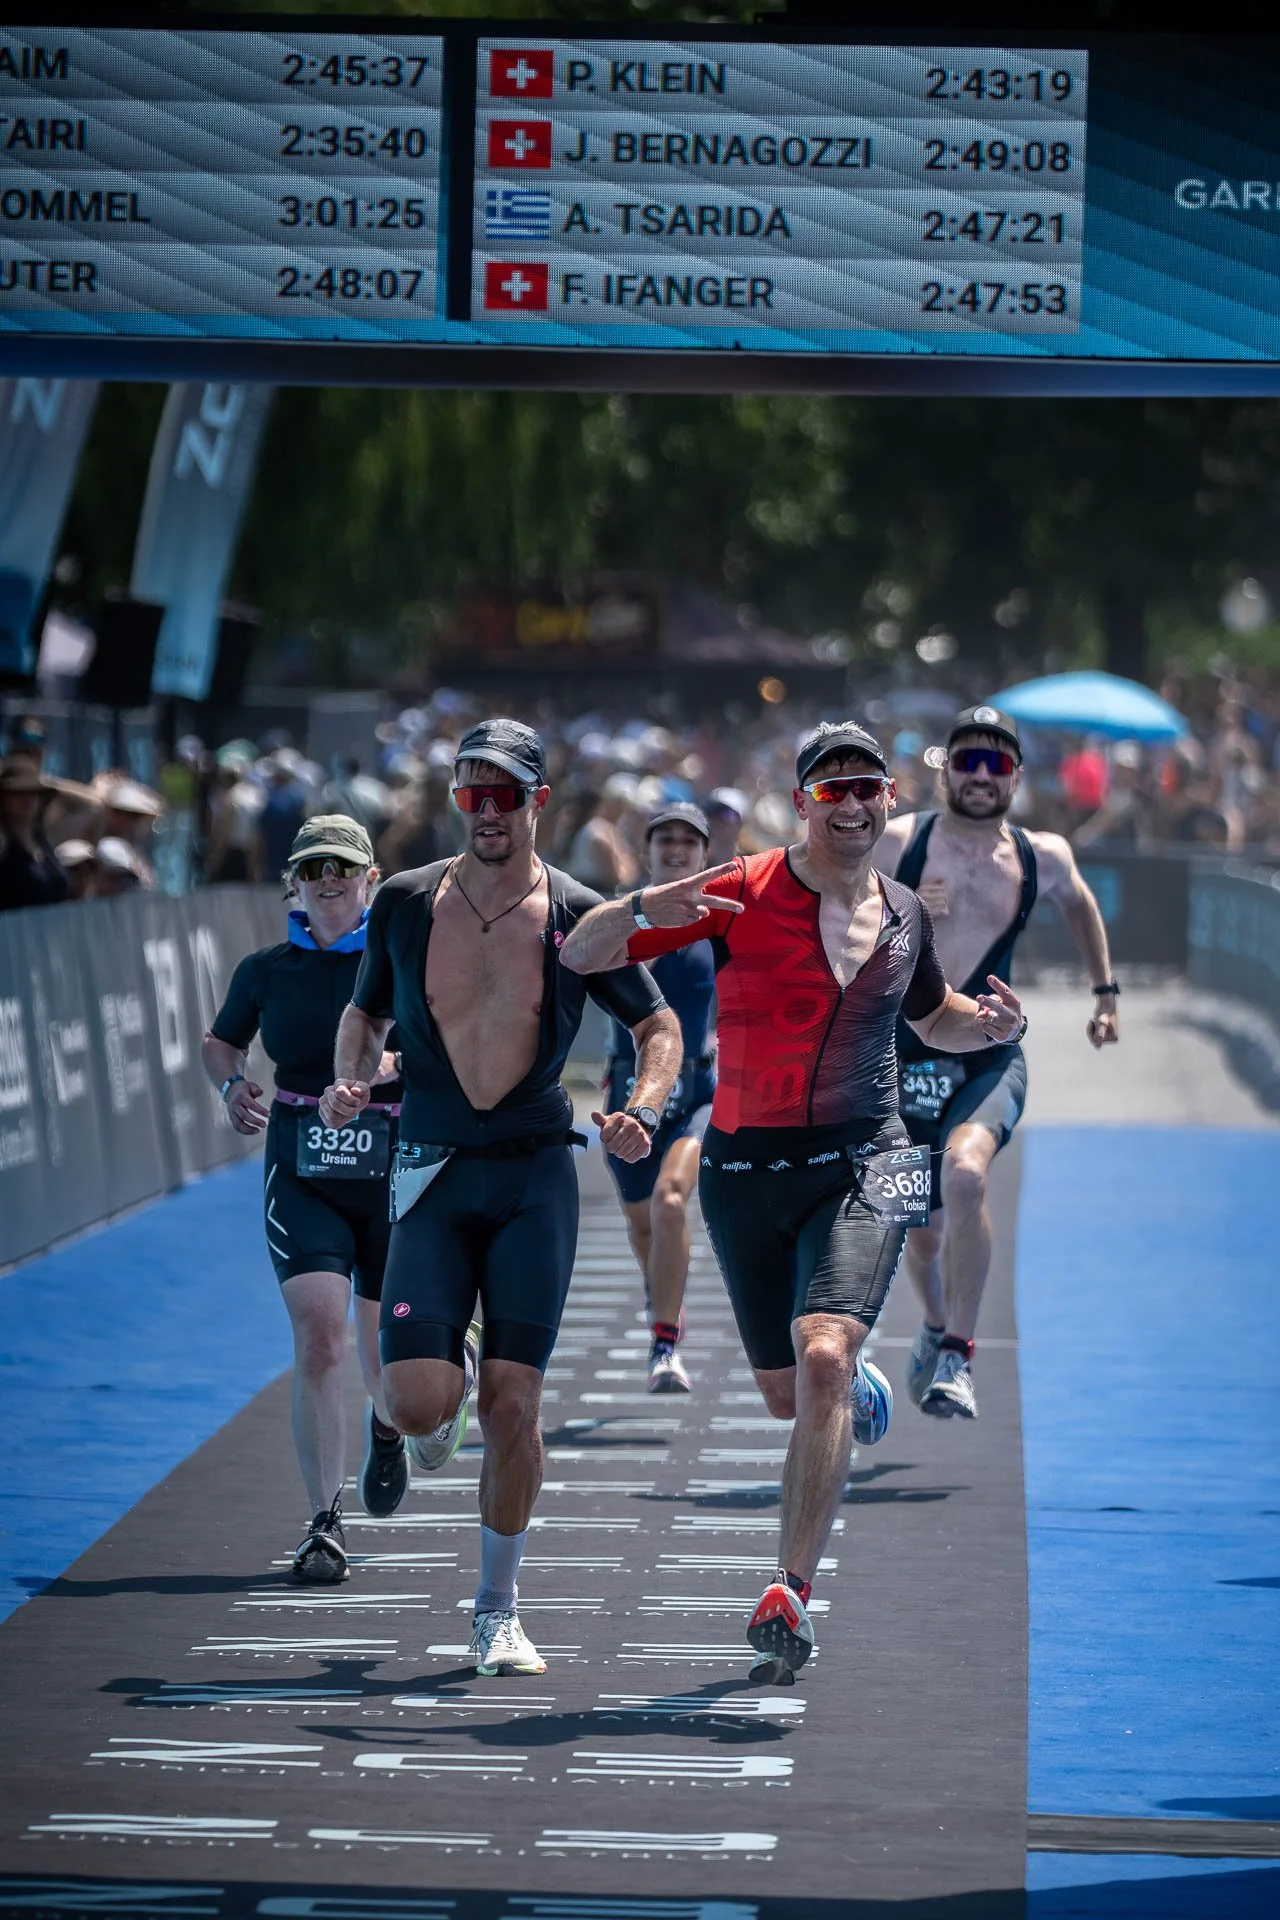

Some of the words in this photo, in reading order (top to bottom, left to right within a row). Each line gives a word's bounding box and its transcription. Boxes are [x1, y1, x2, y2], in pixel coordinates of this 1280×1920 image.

[281, 53, 430, 88] 2:45:37
[565, 60, 597, 93] P.
[609, 61, 727, 94] KLEIN
[925, 68, 1072, 102] 2:43:19
[0, 117, 86, 152] AIRI
[280, 125, 428, 158] 2:35:40
[564, 131, 598, 163] J.
[613, 132, 873, 169] BERNAGOZZI
[924, 139, 1071, 173] 2:49:08
[1, 188, 151, 224] OMMEL
[278, 195, 426, 229] 3:01:25
[1175, 178, 1280, 210] GAR
[562, 203, 600, 235] A.
[614, 203, 792, 239] TSARIDA
[922, 210, 1066, 244] 2:47:21
[276, 266, 424, 300] 2:48:07
[561, 273, 589, 304] F.
[603, 274, 775, 308] IFANGER
[921, 282, 1068, 315] 2:47:53
[307, 1126, 372, 1153] 3320
[320, 1153, 358, 1166] Ursina
[721, 1161, 752, 1172] sailfish
[807, 1150, 840, 1165] sailfish
[901, 1198, 927, 1212] Tobias
[361, 1709, 475, 1718] CITY
[82, 1760, 288, 1776] ZURICH
[319, 1770, 443, 1779] CITY
[472, 1774, 792, 1789] TRIATHLON
